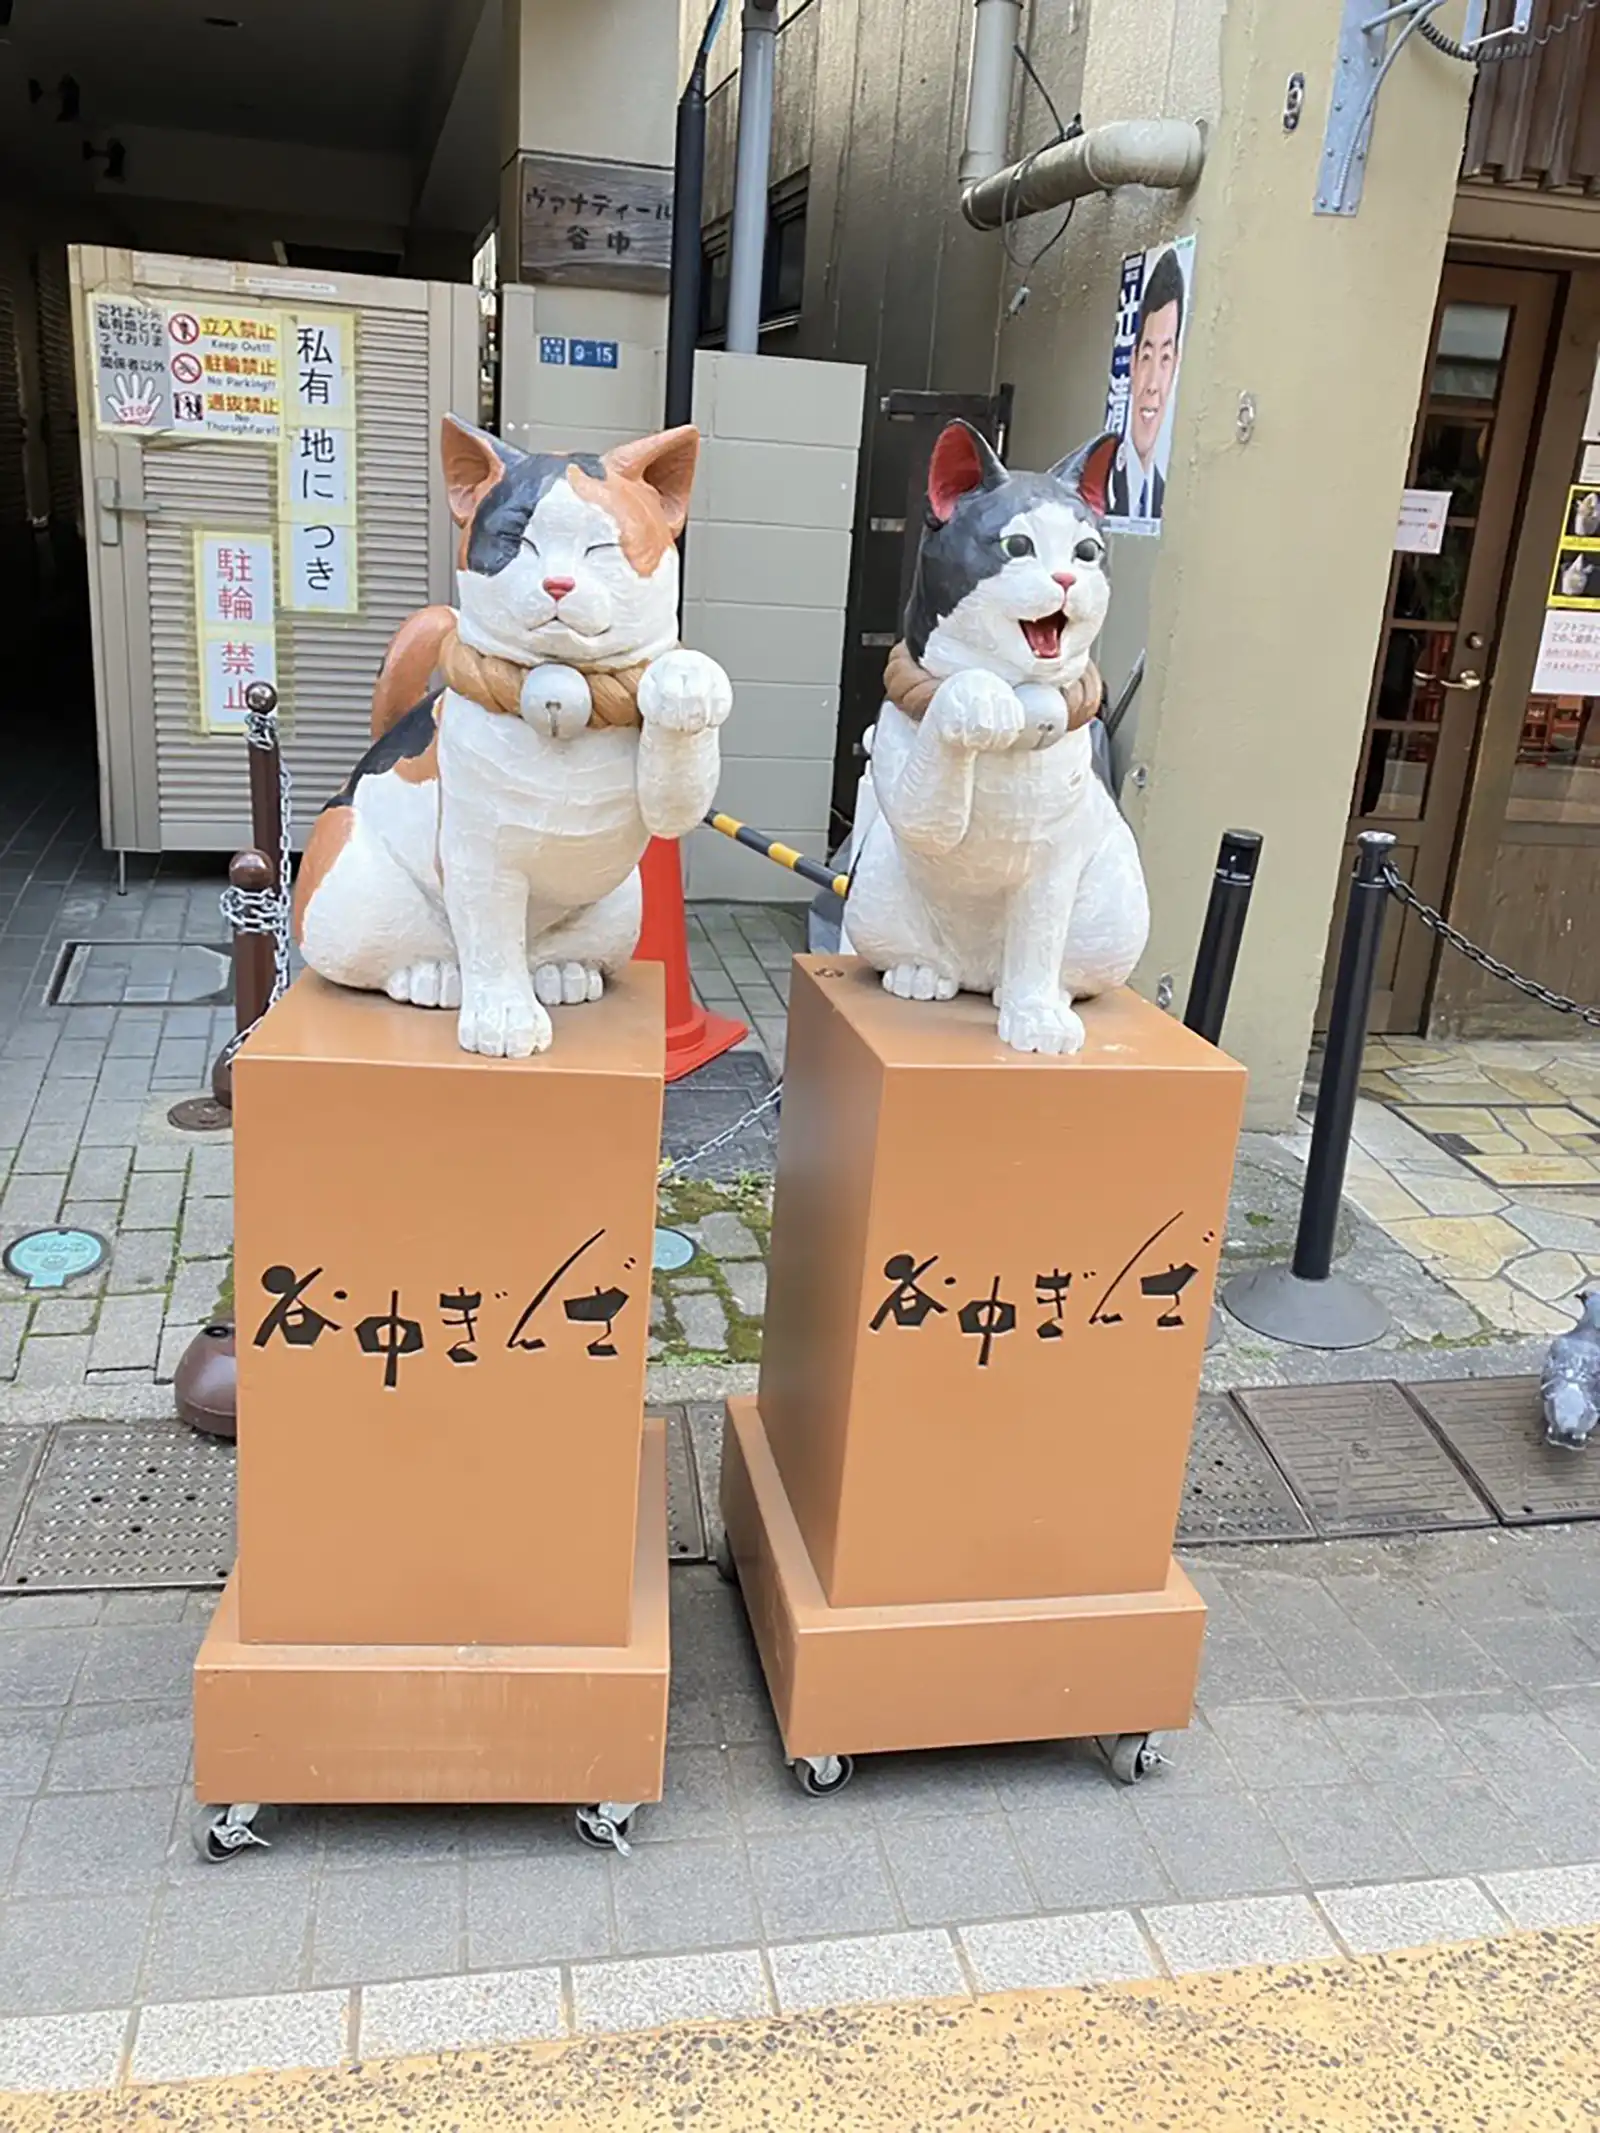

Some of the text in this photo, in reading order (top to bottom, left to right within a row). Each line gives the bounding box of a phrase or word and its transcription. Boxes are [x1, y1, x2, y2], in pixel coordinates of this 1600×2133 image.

[567, 225, 632, 255] 谷中
[201, 317, 277, 341] 立入禁止
[211, 339, 238, 352] Keep
[574, 344, 613, 363] 9-15
[100, 356, 165, 373] 関係者以外
[204, 354, 277, 377] 駐輪禁止
[207, 375, 222, 384] No
[119, 405, 152, 419] STOP
[207, 392, 280, 416] 通抜禁止
[235, 413, 251, 423] No
[217, 547, 255, 711] 駐輪禁止
[868, 1211, 1216, 1366] 谷中ぎんざ
[252, 1228, 638, 1389] 谷中ぎんざ
